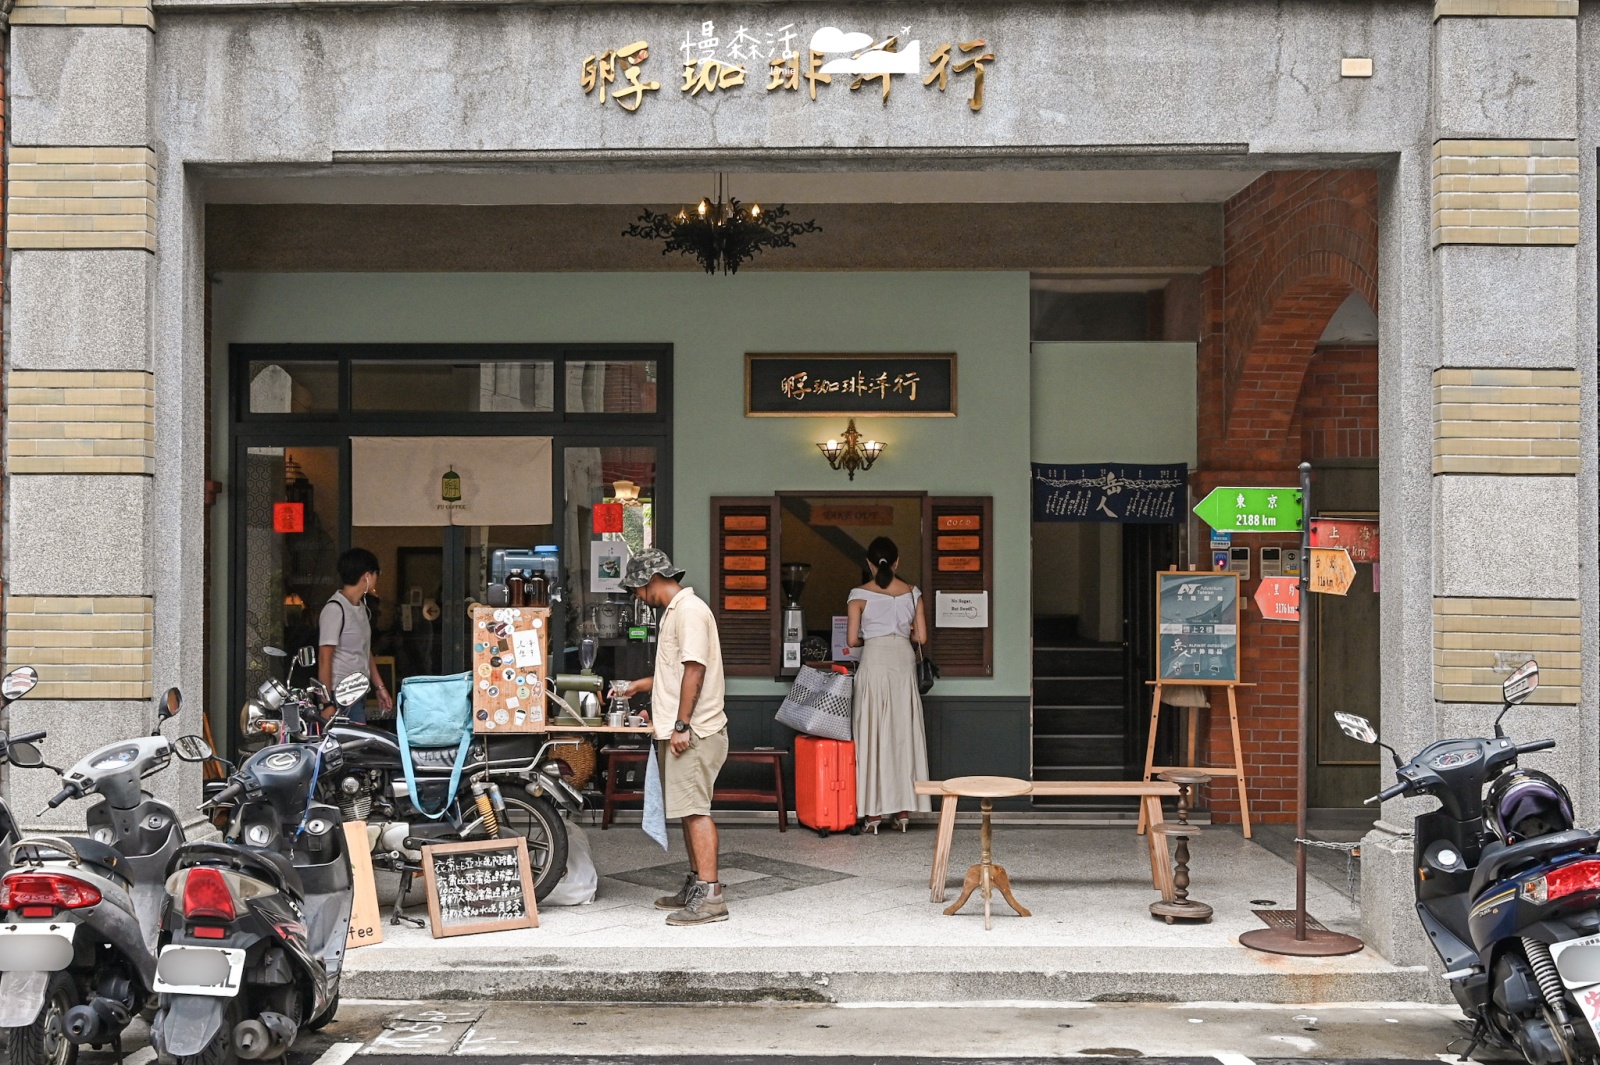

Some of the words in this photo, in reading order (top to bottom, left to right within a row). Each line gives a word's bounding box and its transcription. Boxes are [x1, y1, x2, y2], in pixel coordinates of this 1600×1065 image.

[780, 370, 921, 401] 孵珈琲洋行
[1096, 471, 1125, 518] 岳人
[1235, 493, 1279, 509] 東京
[1235, 514, 1260, 526] 2188
[1262, 514, 1277, 526] km
